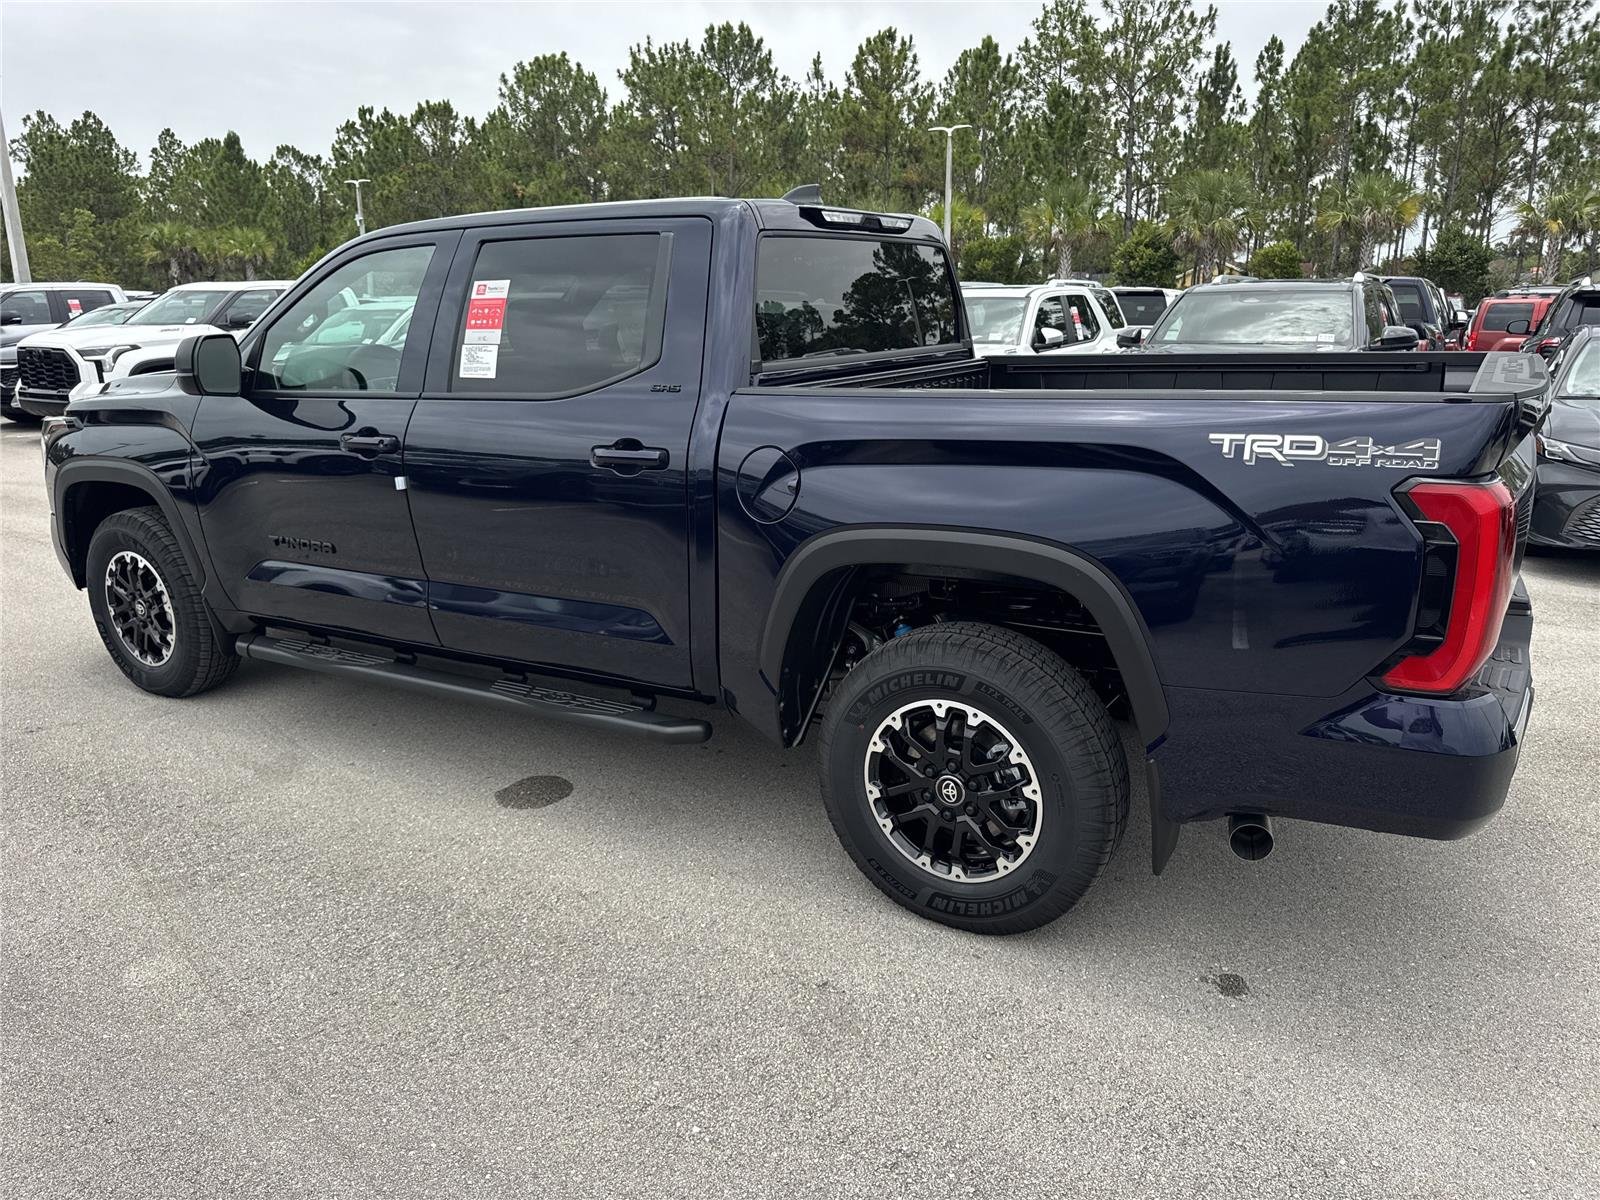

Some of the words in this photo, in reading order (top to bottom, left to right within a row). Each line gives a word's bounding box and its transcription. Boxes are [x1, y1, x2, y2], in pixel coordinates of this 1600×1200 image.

[1208, 433, 1329, 467] TRD
[1328, 436, 1442, 461] 4x4
[1327, 457, 1372, 467] OFF
[1374, 458, 1440, 470] ROAD
[268, 534, 337, 554] TUNDRA
[867, 673, 960, 704] MICHELIN
[930, 890, 1029, 915] MICHELIN
